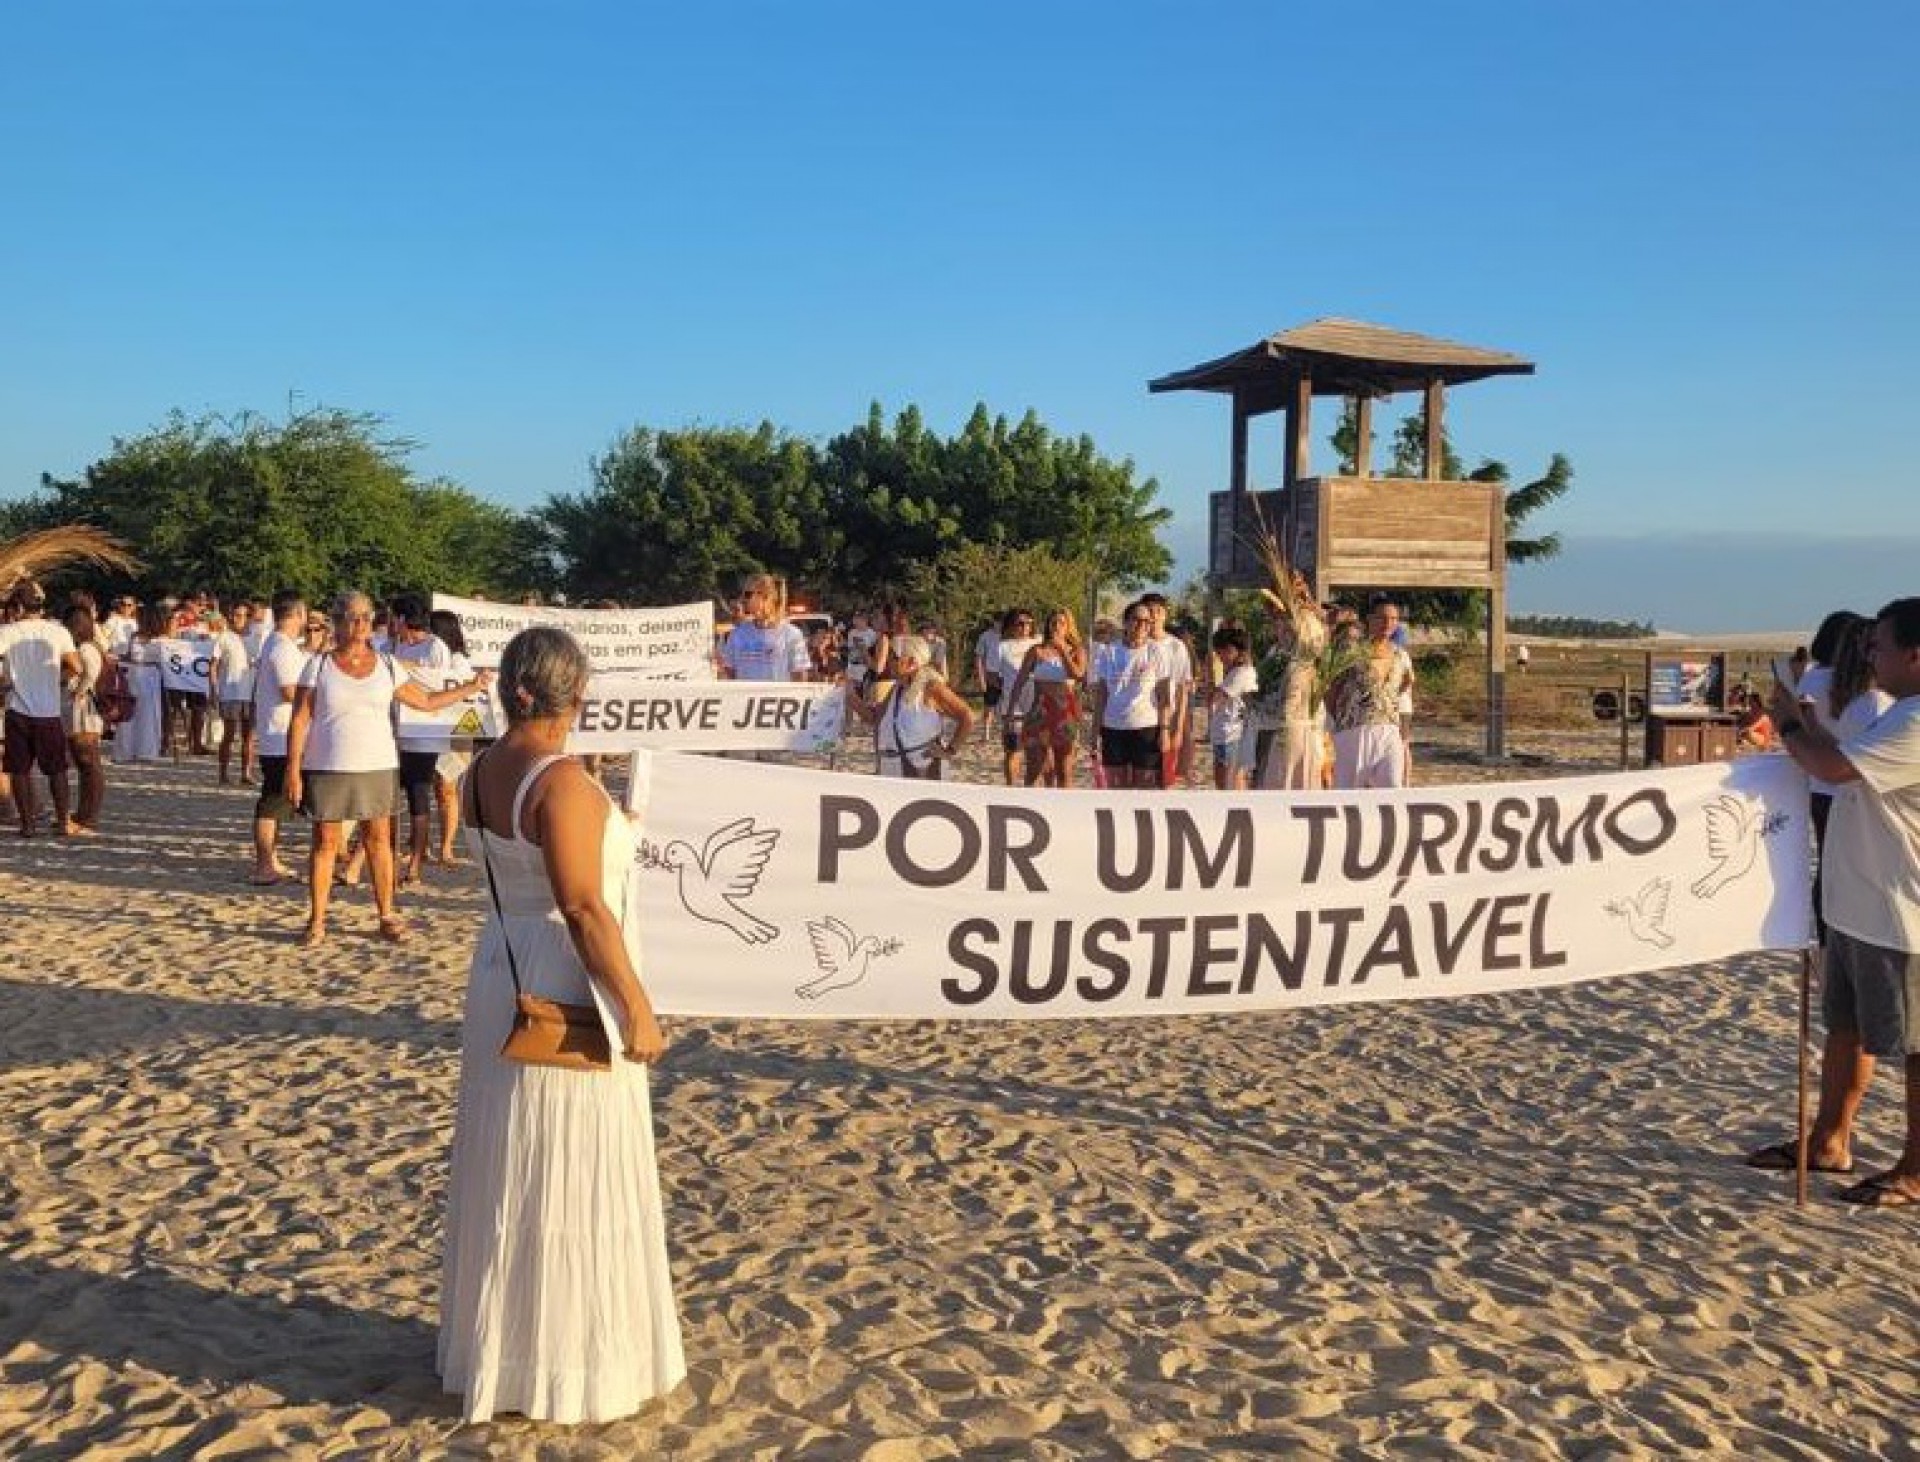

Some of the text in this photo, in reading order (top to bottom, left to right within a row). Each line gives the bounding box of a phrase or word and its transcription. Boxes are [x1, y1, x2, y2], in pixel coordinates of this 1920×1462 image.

[639, 619, 700, 635] deixem
[579, 696, 811, 732] ESERVE JERI
[817, 789, 1677, 892] POR UM TURISMO
[940, 880, 1567, 1005] SUSTENTÁVEL
